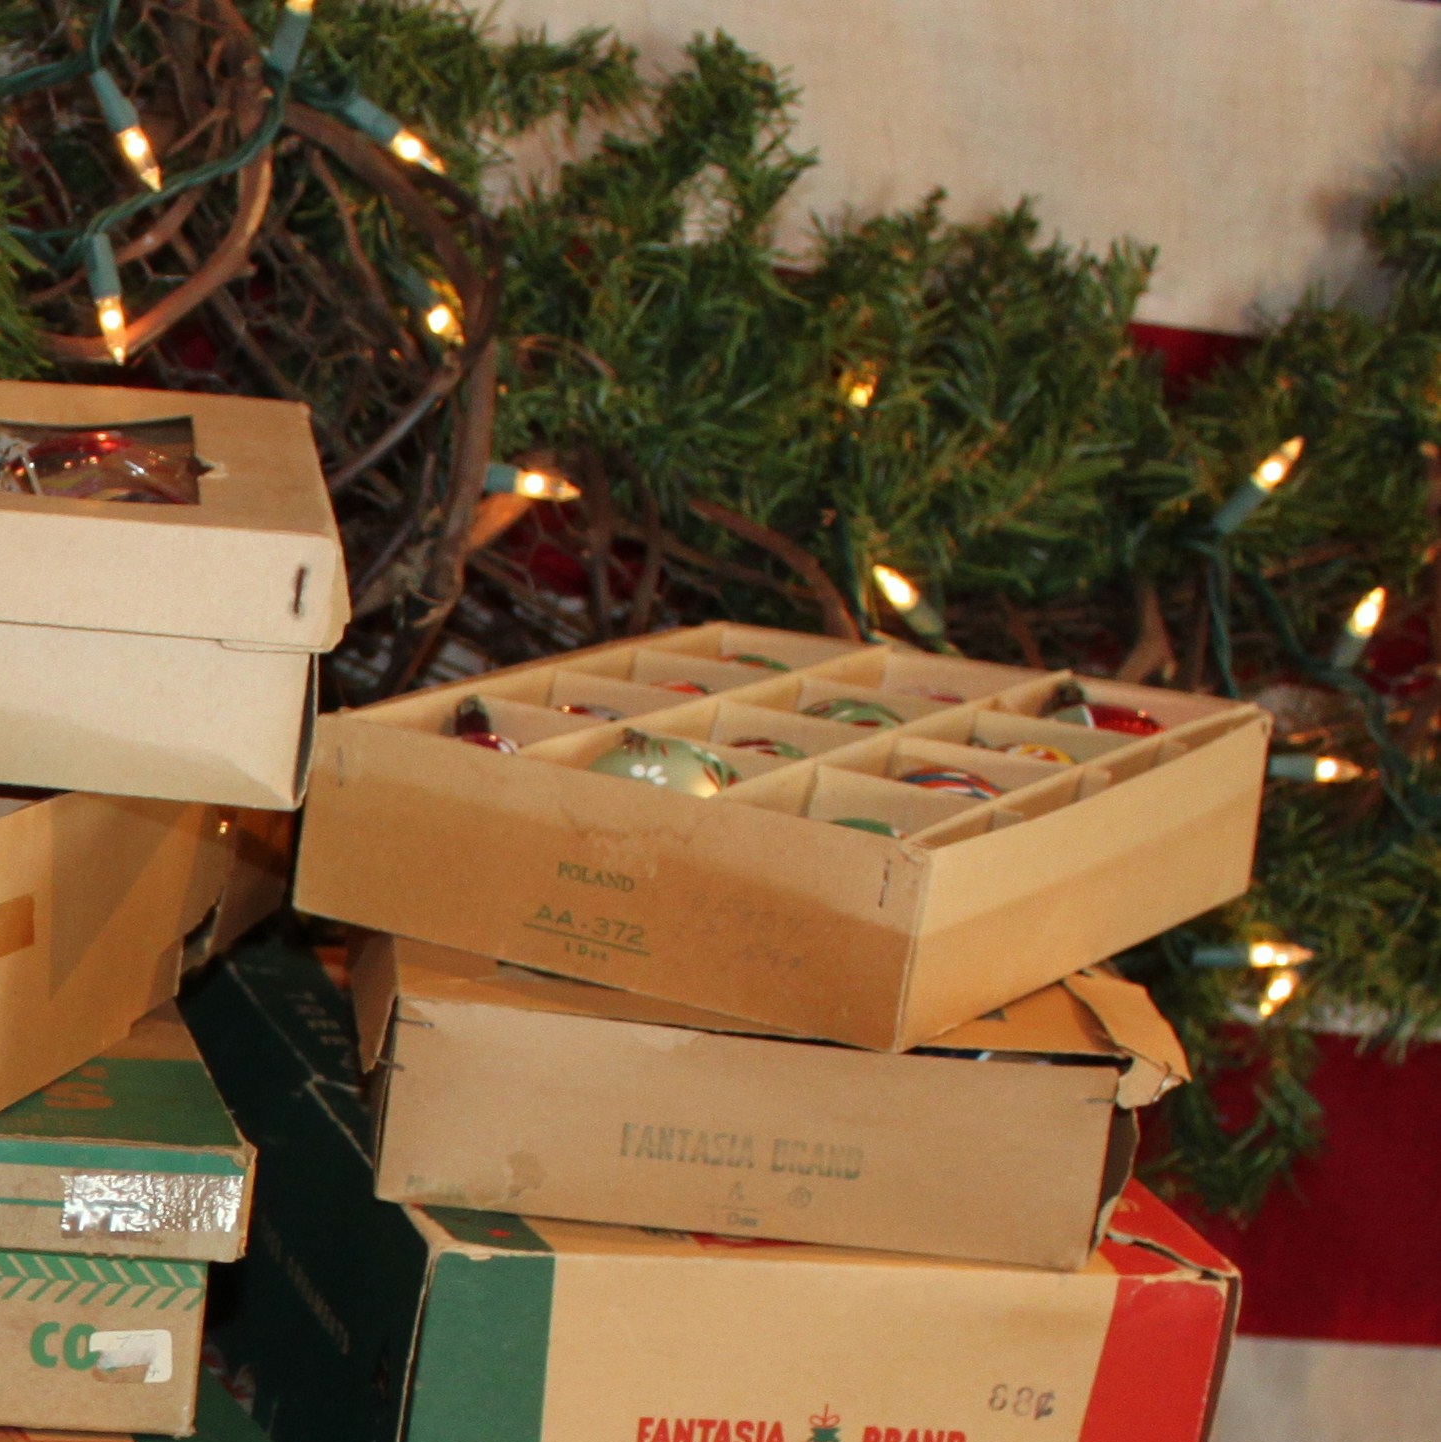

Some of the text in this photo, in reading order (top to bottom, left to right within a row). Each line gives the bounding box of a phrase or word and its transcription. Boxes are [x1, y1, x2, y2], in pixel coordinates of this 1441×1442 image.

[558, 862, 635, 893] POLAND
[620, 1121, 865, 1180] FANTASIA BRAND
